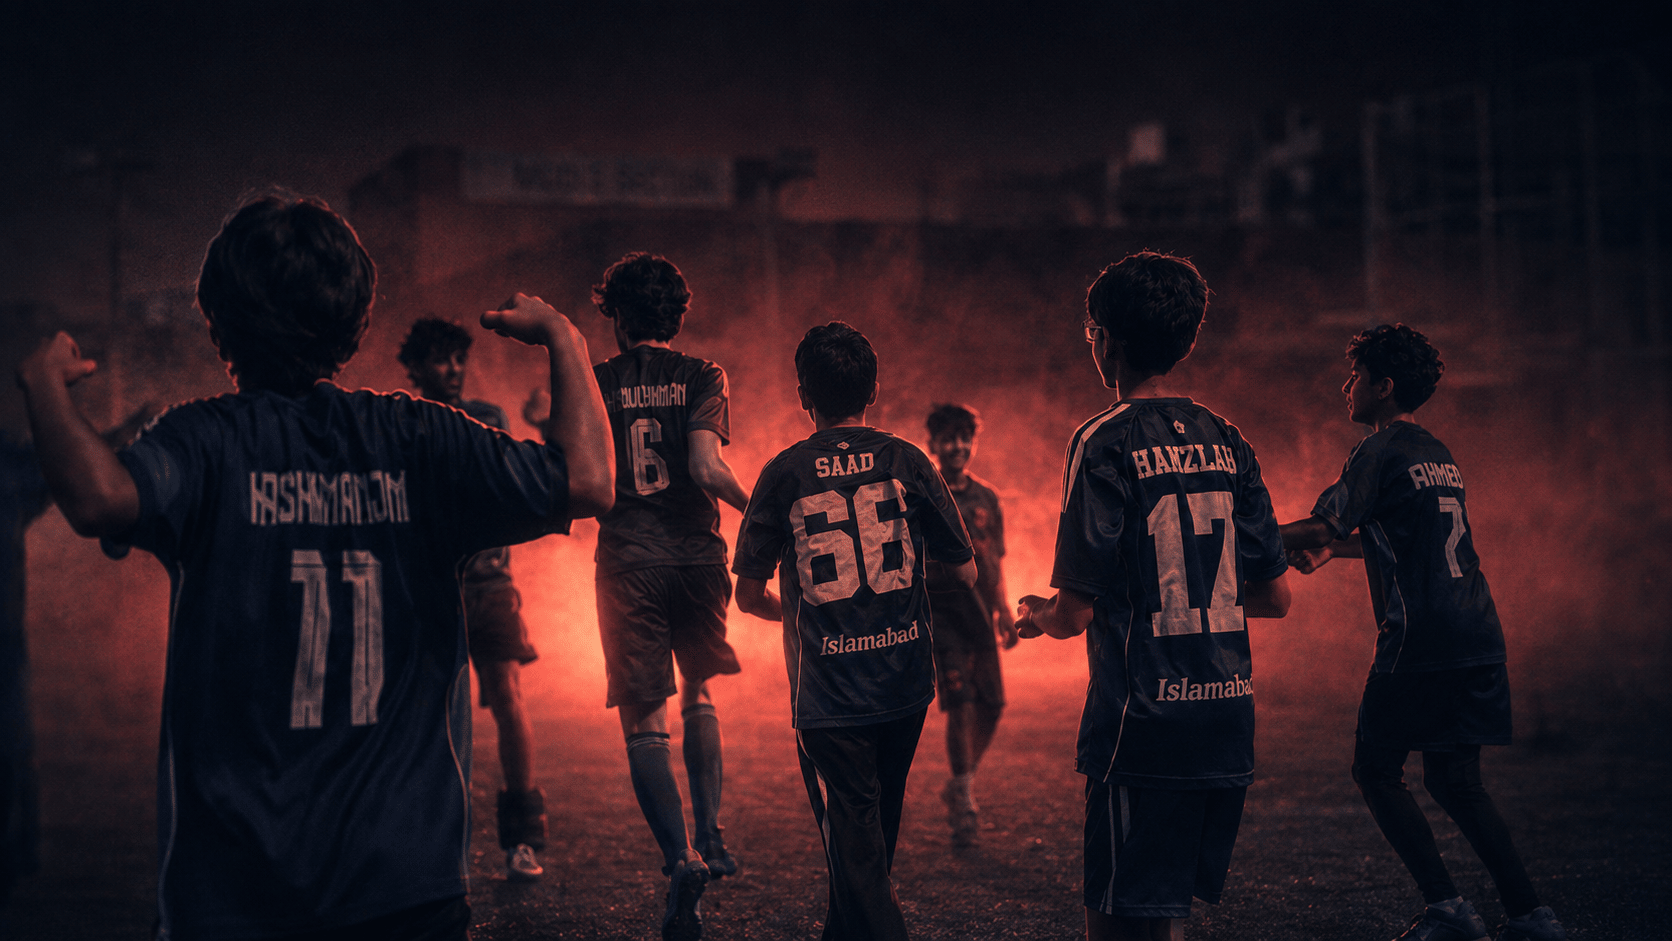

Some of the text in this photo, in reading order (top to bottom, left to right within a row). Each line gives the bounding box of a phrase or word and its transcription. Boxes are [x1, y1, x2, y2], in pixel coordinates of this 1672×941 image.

[630, 417, 670, 496] 6
[815, 452, 874, 478] SAAD
[790, 478, 915, 606] 66
[1146, 491, 1245, 637] 17
[1438, 496, 1466, 578] 7
[289, 549, 385, 729] 11
[820, 620, 919, 656] Islamabad
